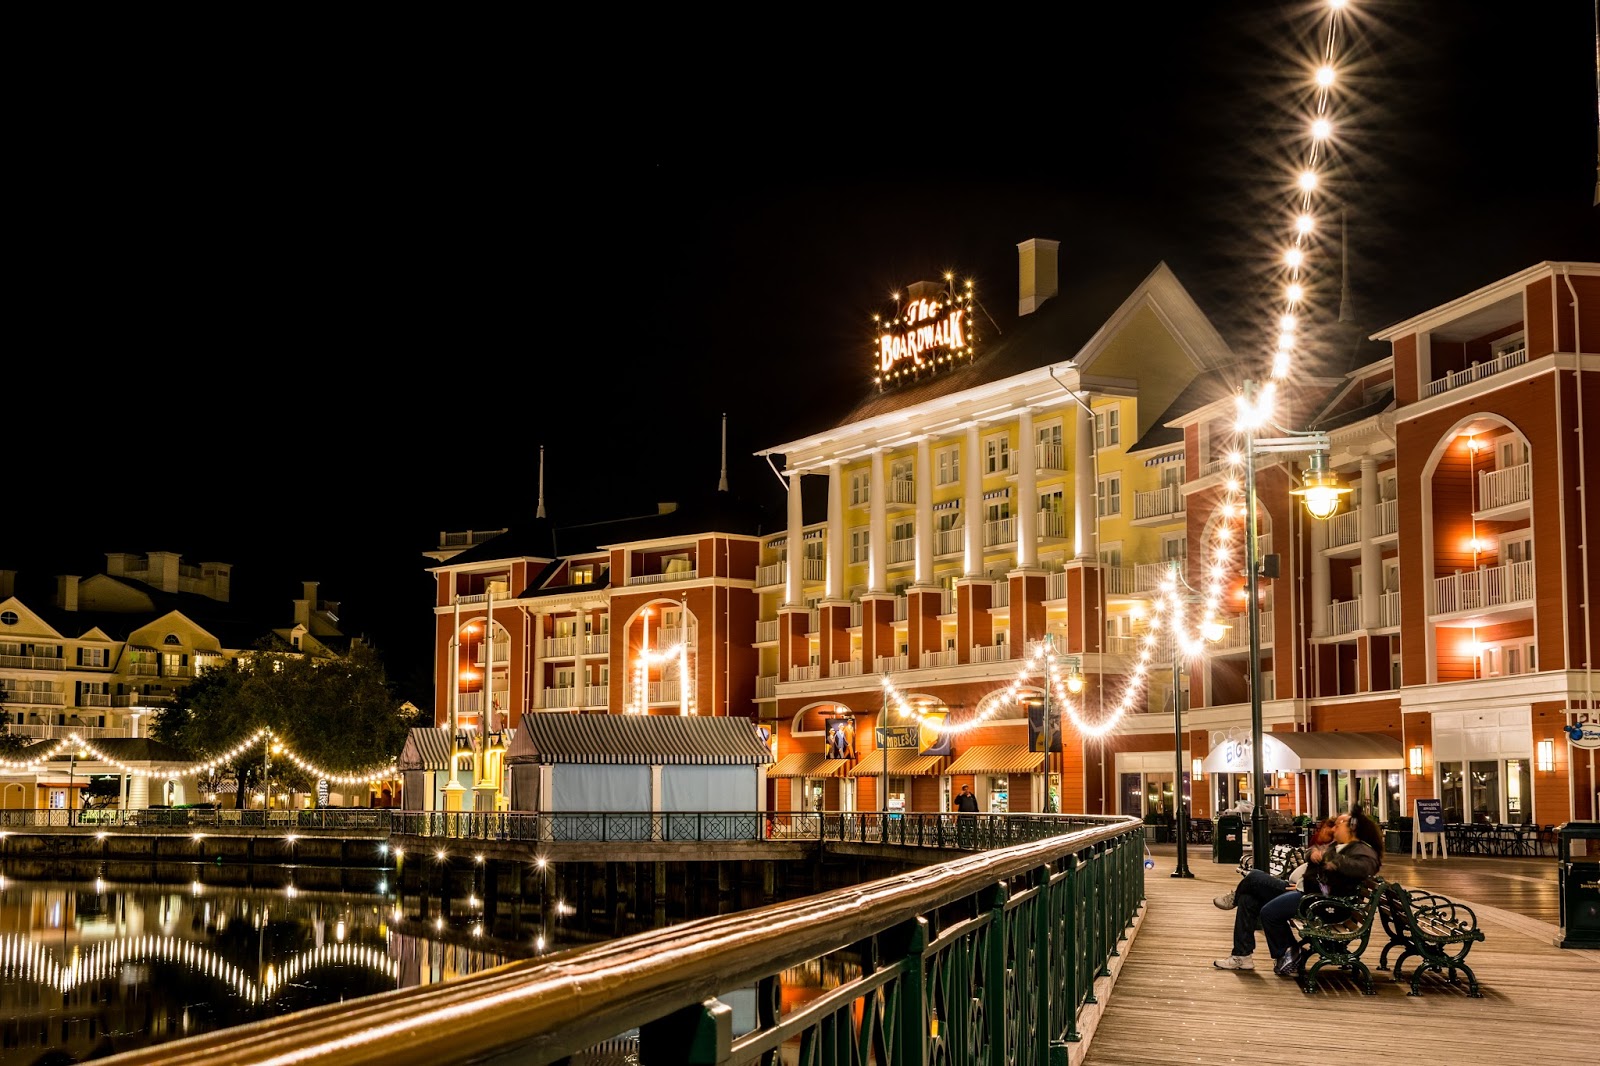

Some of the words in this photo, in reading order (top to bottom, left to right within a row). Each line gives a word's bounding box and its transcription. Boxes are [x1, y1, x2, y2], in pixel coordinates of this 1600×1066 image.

[906, 297, 938, 326] The
[880, 309, 964, 372] BOARDWALK
[876, 731, 909, 748] THMBLES
[1226, 741, 1243, 763] BIG
